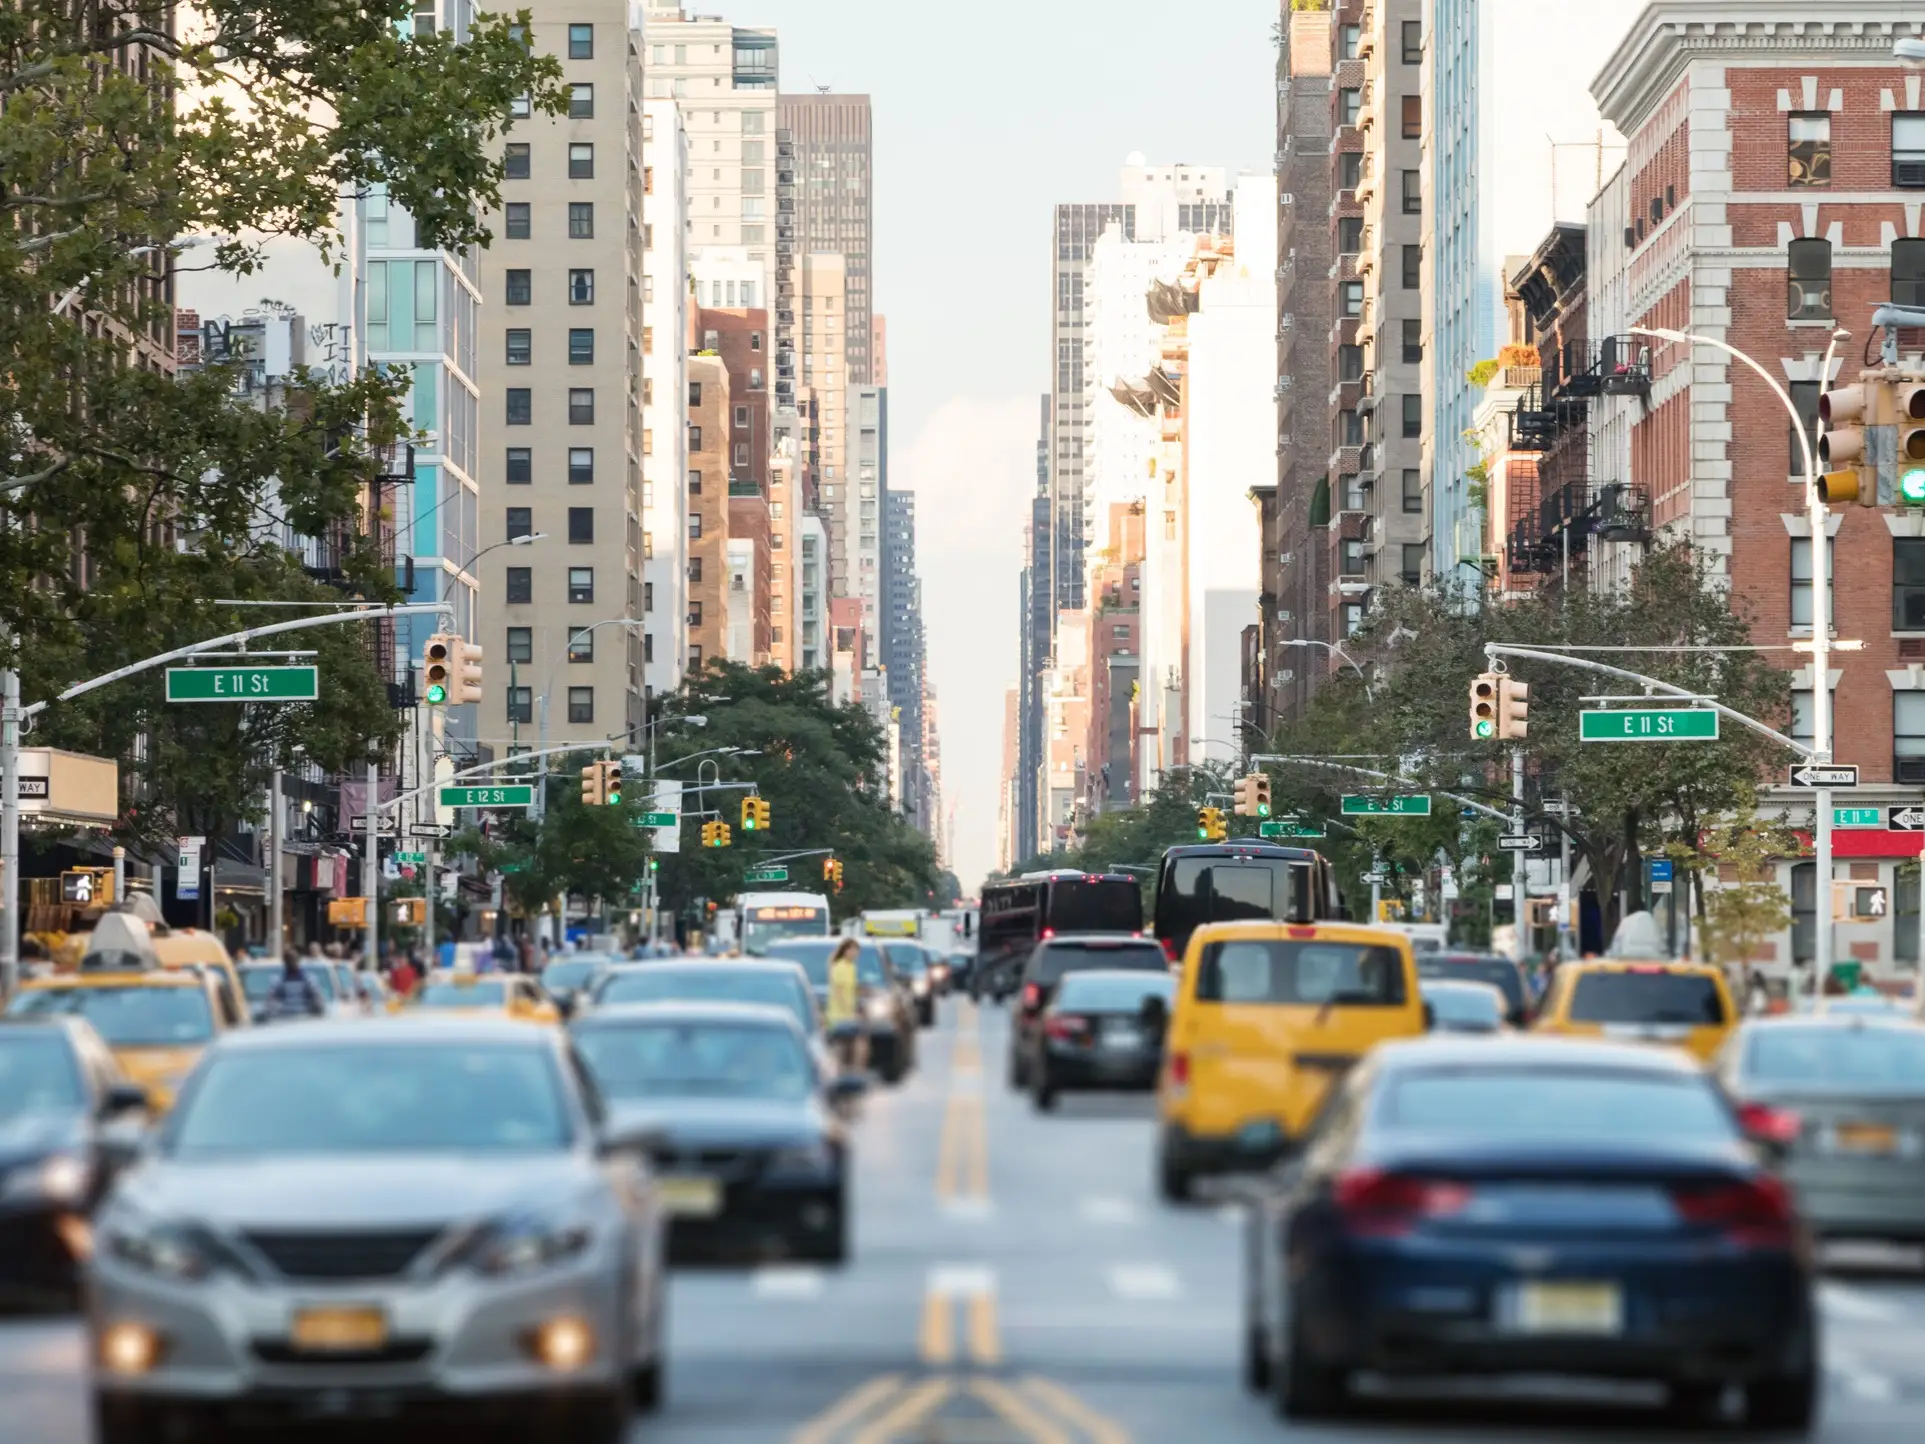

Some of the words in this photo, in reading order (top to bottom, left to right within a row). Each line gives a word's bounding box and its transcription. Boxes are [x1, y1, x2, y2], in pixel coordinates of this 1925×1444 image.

[214, 674, 224, 693] E
[232, 674, 243, 693] 11
[251, 674, 269, 693] St
[1623, 716, 1634, 733] E
[1641, 716, 1650, 733] 11
[1657, 715, 1674, 733] St
[1803, 772, 1820, 780] ONE
[1831, 772, 1850, 780] WAY
[18, 782, 40, 792] WAY
[467, 791, 474, 803] E
[478, 790, 489, 803] 12
[493, 790, 505, 802] St
[1392, 799, 1404, 811] St
[1840, 810, 1847, 823] E
[1852, 810, 1860, 823] 11
[1903, 814, 1922, 823] ONE
